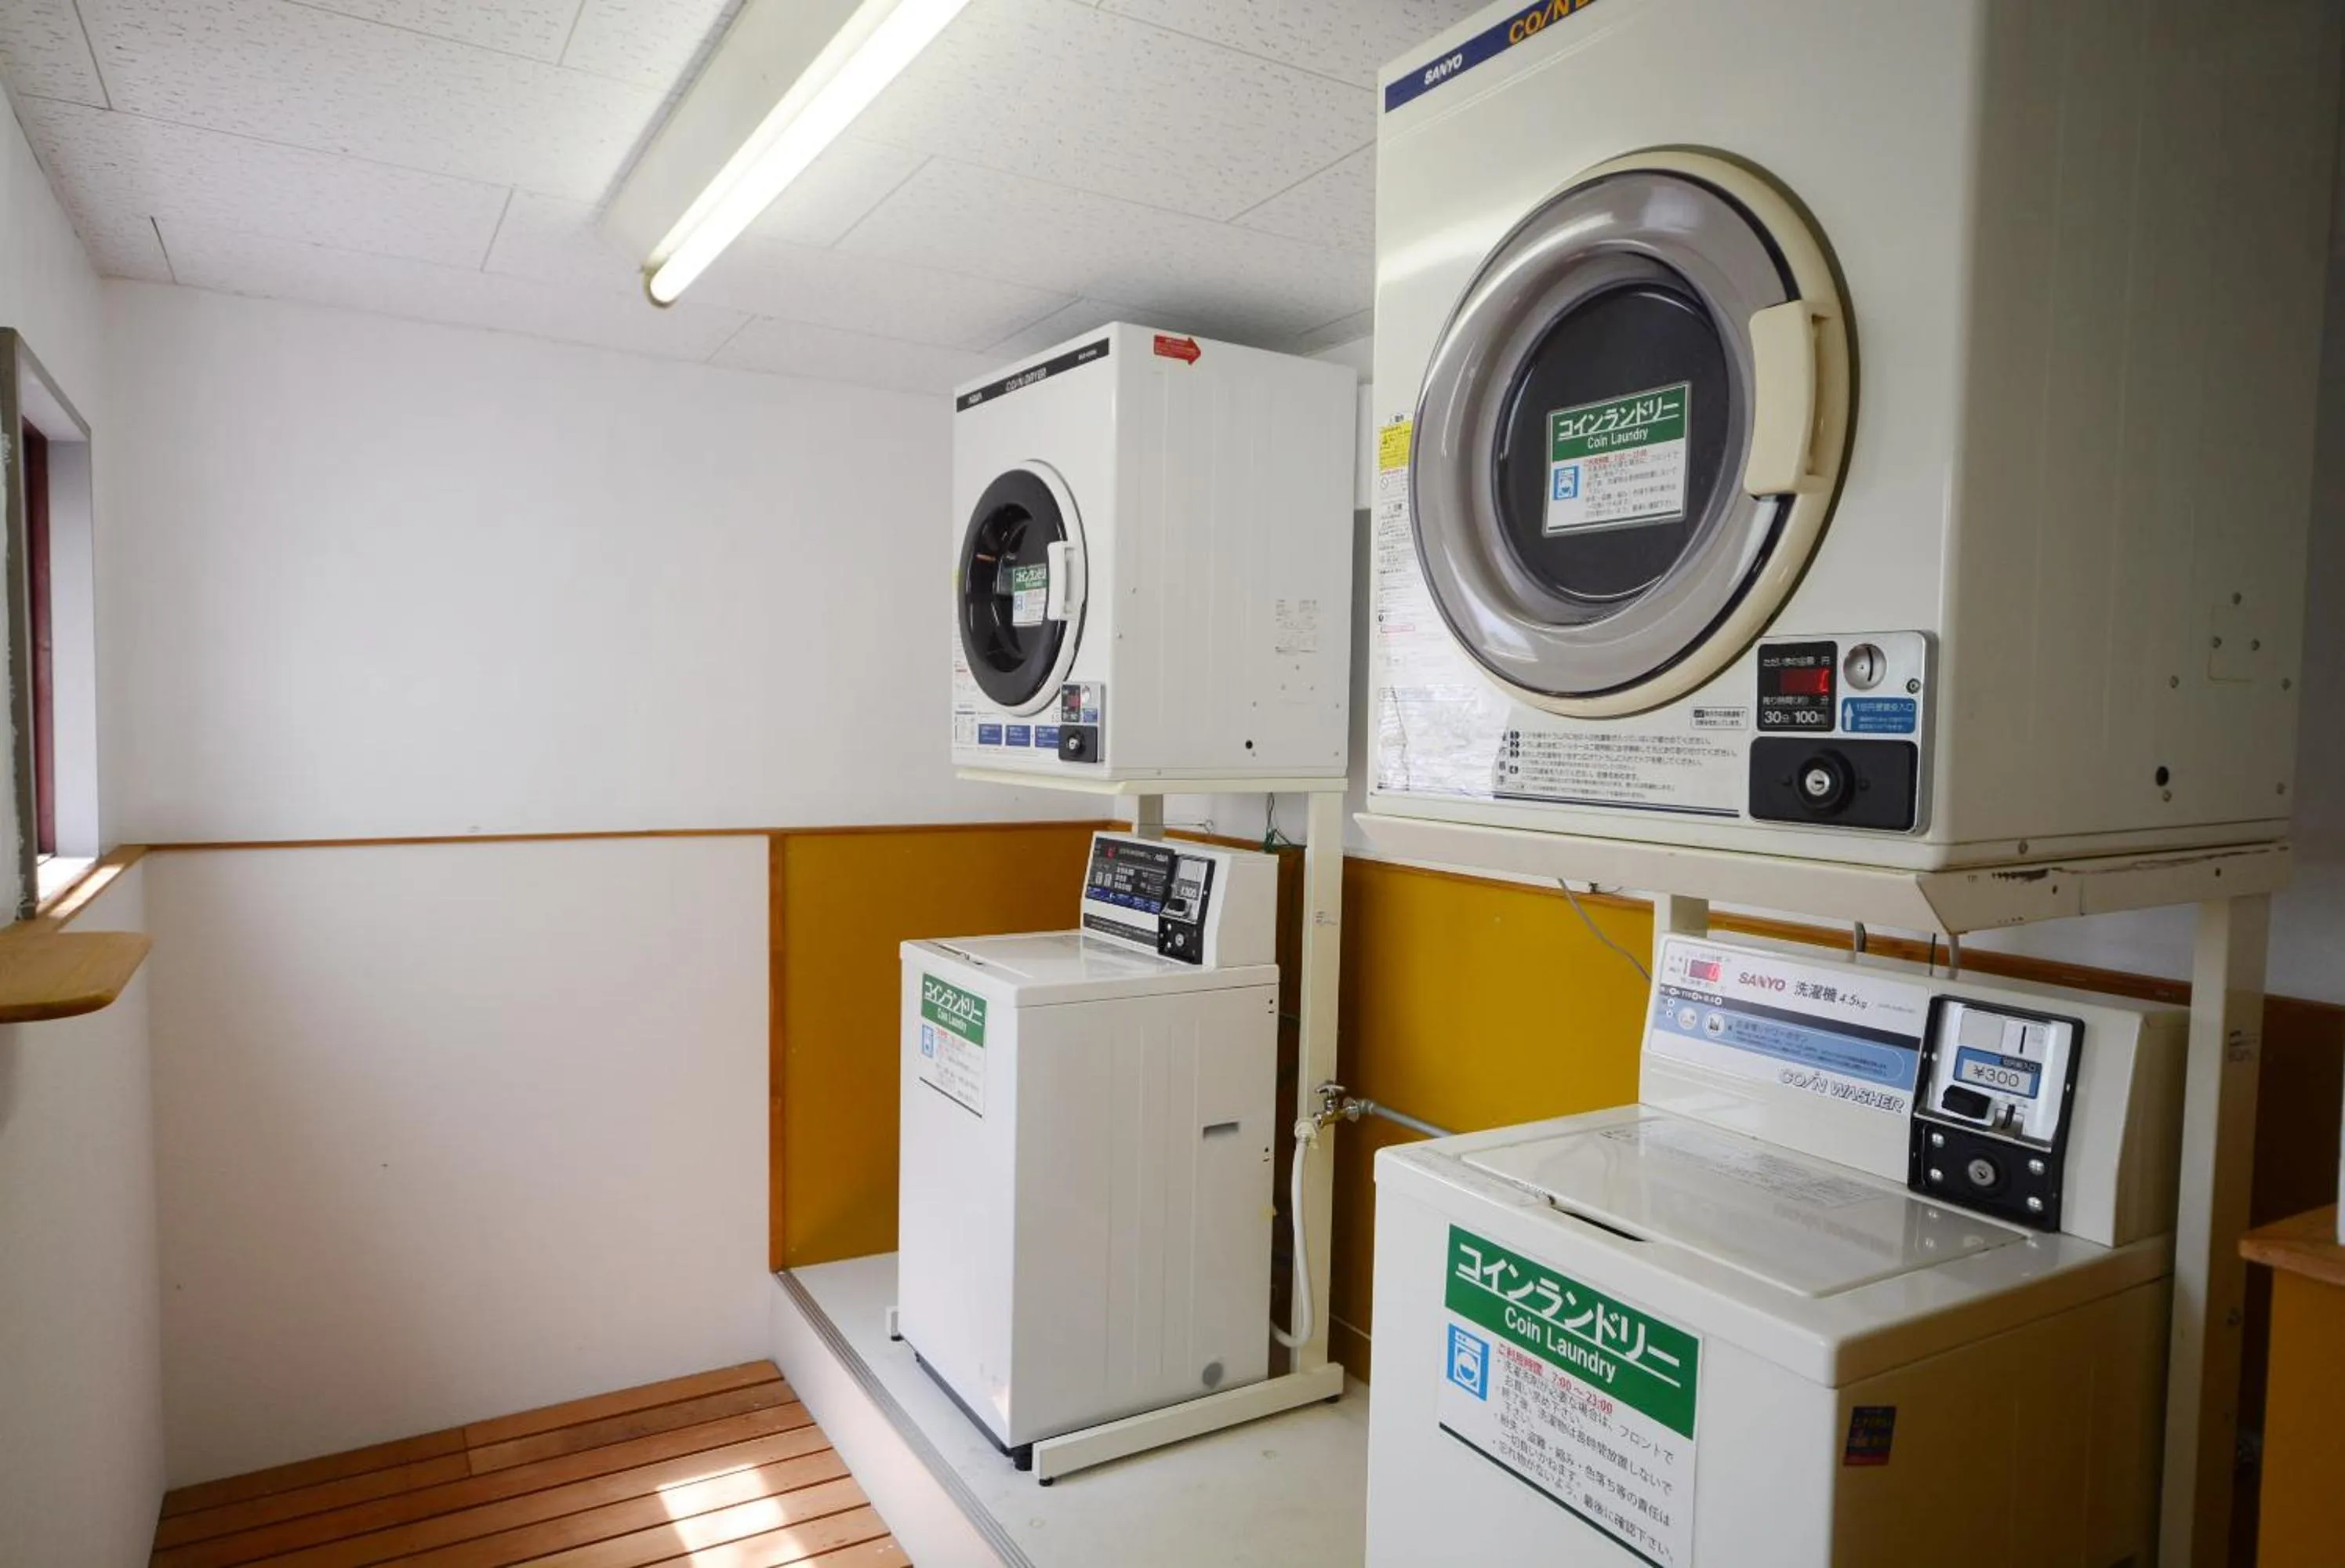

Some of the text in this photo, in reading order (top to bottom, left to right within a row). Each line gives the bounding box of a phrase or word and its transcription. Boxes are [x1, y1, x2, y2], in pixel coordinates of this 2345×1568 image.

[1424, 53, 1463, 85] SANYO
[1559, 397, 1679, 438] コインランドリー
[1588, 427, 1648, 448] Coin Laundry
[1738, 972, 1786, 993] SANYO
[1794, 980, 1839, 1004] 洗濯機
[1972, 1064, 2020, 1088] ¥300
[1831, 1083, 1905, 1113] WASHER
[1457, 1243, 1680, 1368] コインランドリー
[1505, 1307, 1616, 1384] Coin Laundry
